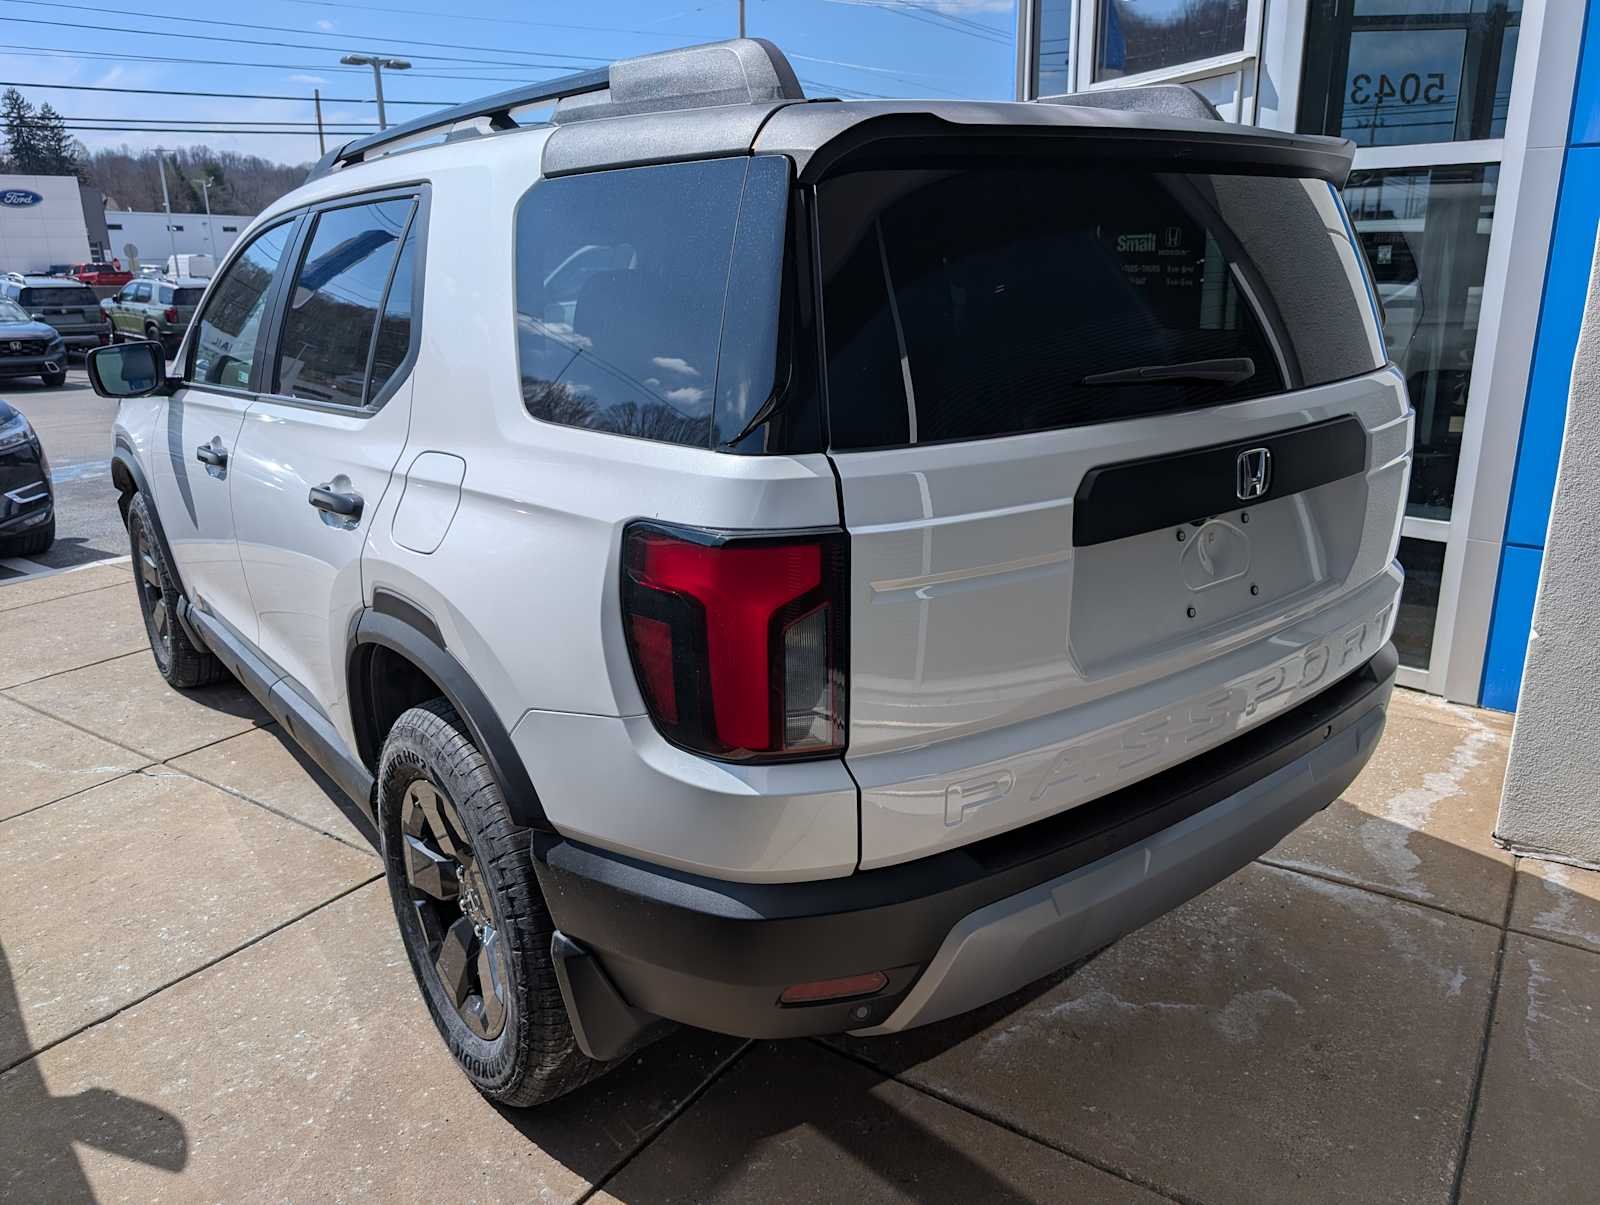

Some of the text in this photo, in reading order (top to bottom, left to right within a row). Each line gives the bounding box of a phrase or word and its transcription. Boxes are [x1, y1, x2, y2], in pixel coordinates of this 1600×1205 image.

[4, 191, 33, 204] Ford
[1117, 233, 1156, 252] Small
[944, 601, 1394, 828] PASSPORT
